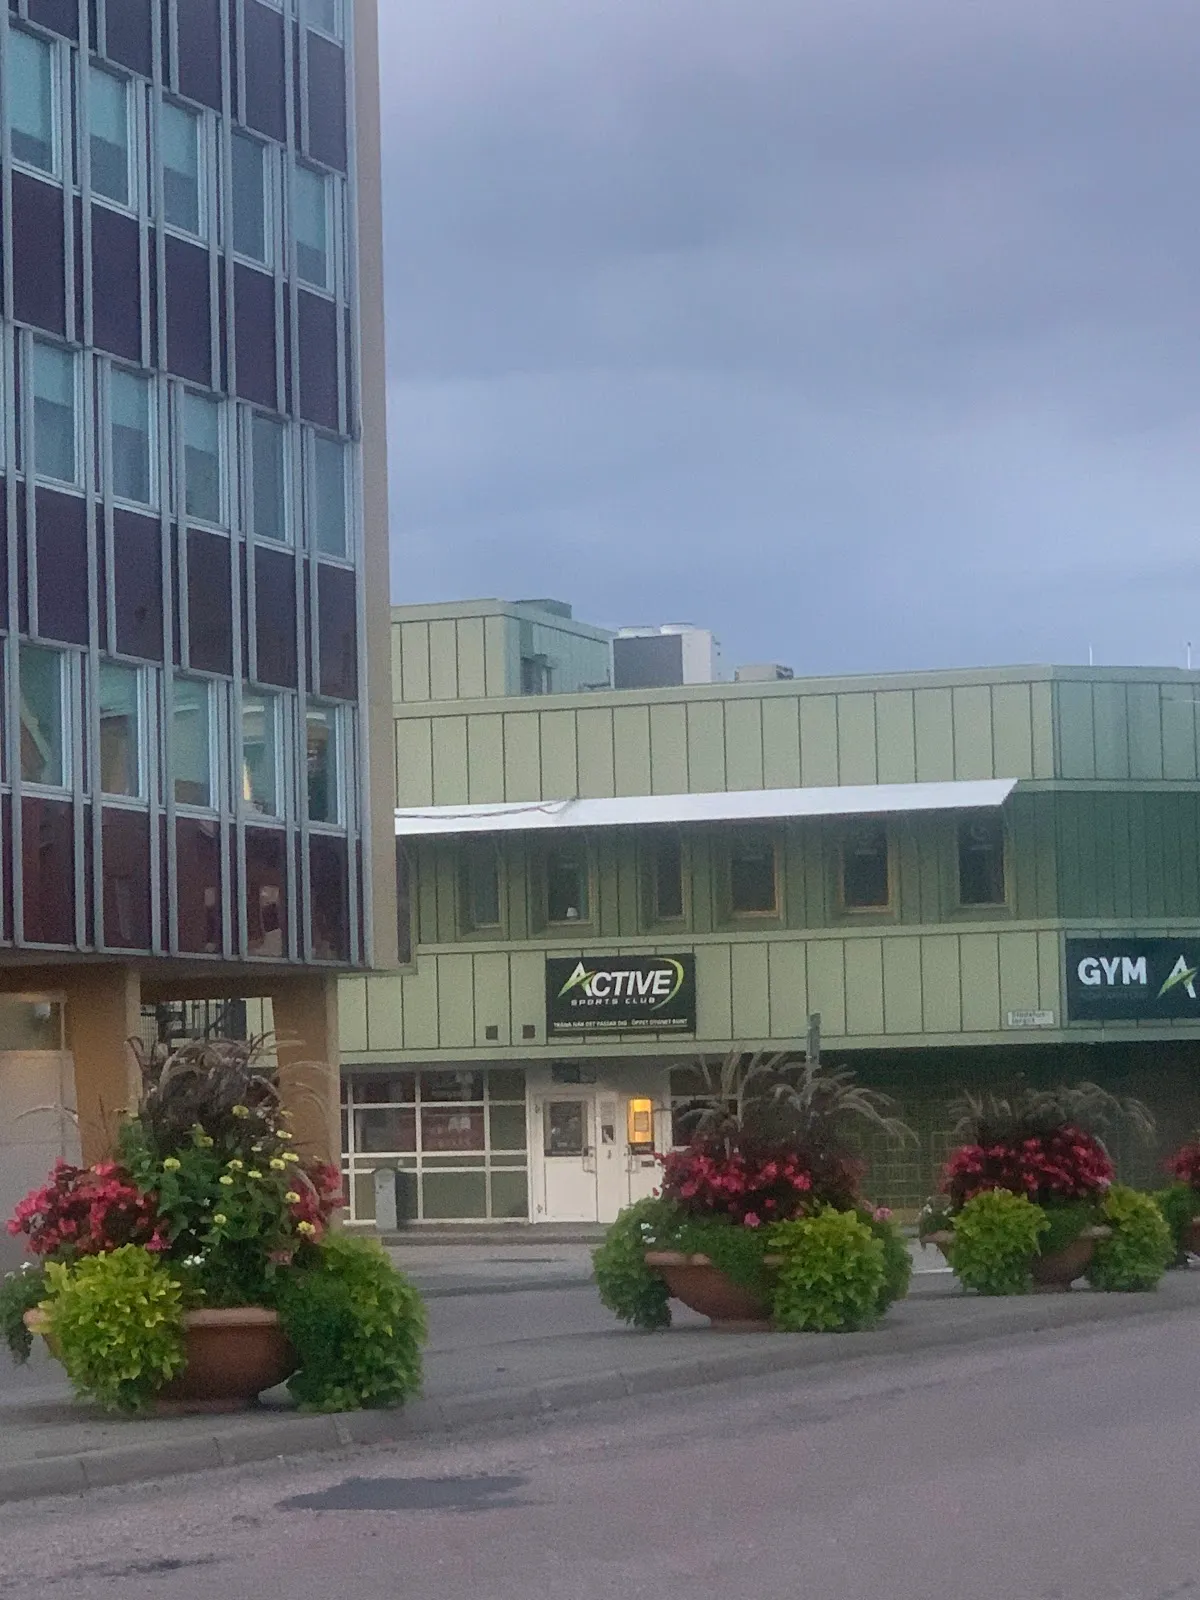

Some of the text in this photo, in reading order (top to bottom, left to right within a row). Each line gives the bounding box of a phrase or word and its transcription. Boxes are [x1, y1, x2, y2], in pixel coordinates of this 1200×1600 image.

[557, 961, 673, 998] ACTIVE
[1077, 956, 1147, 986] GYM
[570, 997, 656, 1006] SPORTS CLUB
